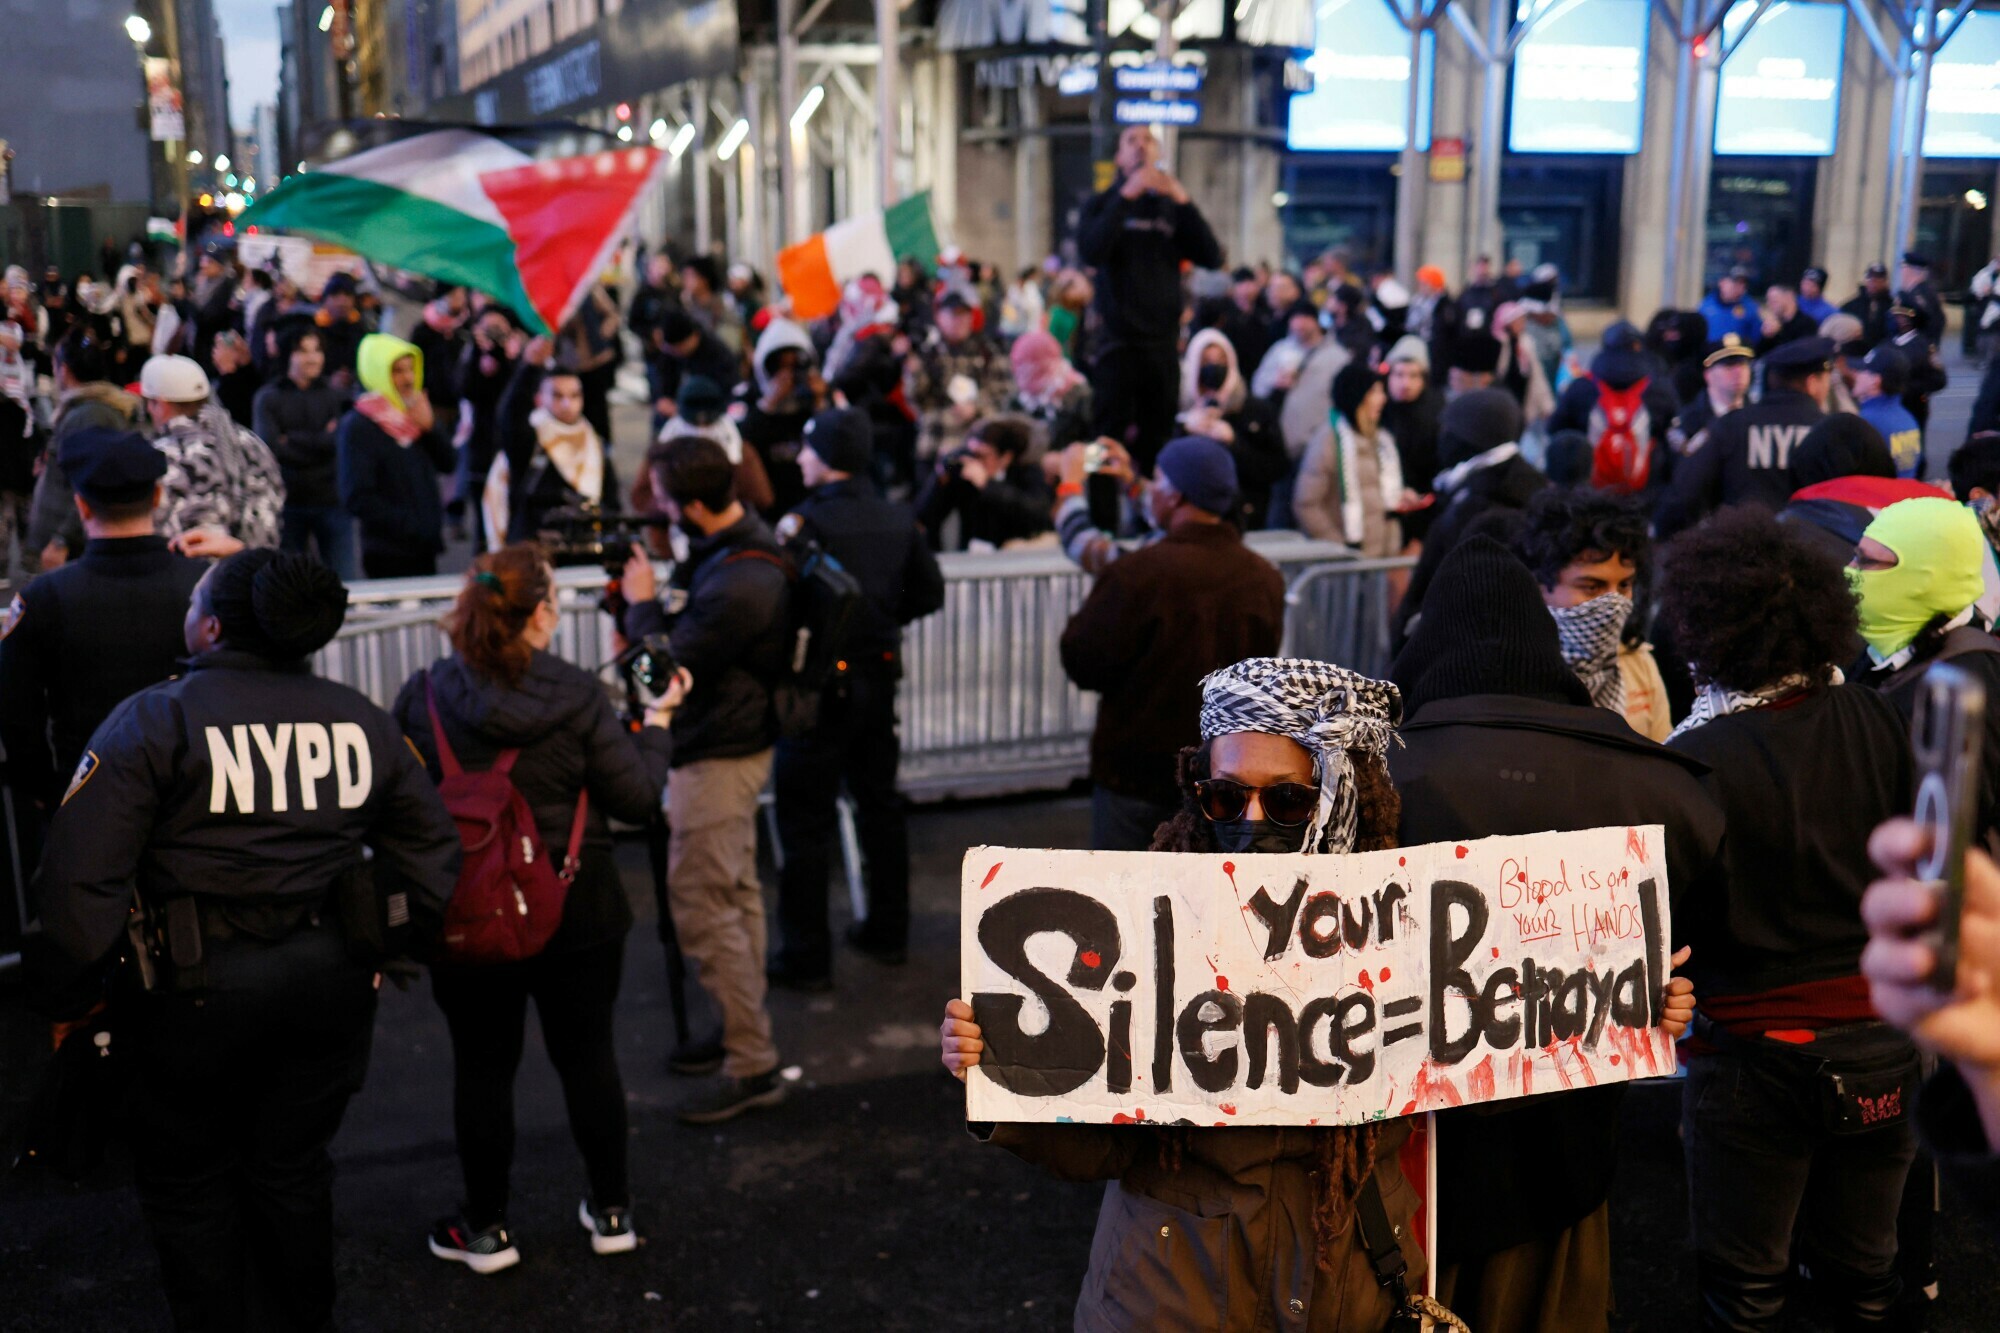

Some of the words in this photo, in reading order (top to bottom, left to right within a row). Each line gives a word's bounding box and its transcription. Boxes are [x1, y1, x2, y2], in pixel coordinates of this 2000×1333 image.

[1747, 424, 1812, 470] NY
[204, 722, 373, 814] NYPD
[1499, 856, 1573, 909] Blood
[1580, 865, 1601, 890] is
[1571, 903, 1643, 952] HANDS
